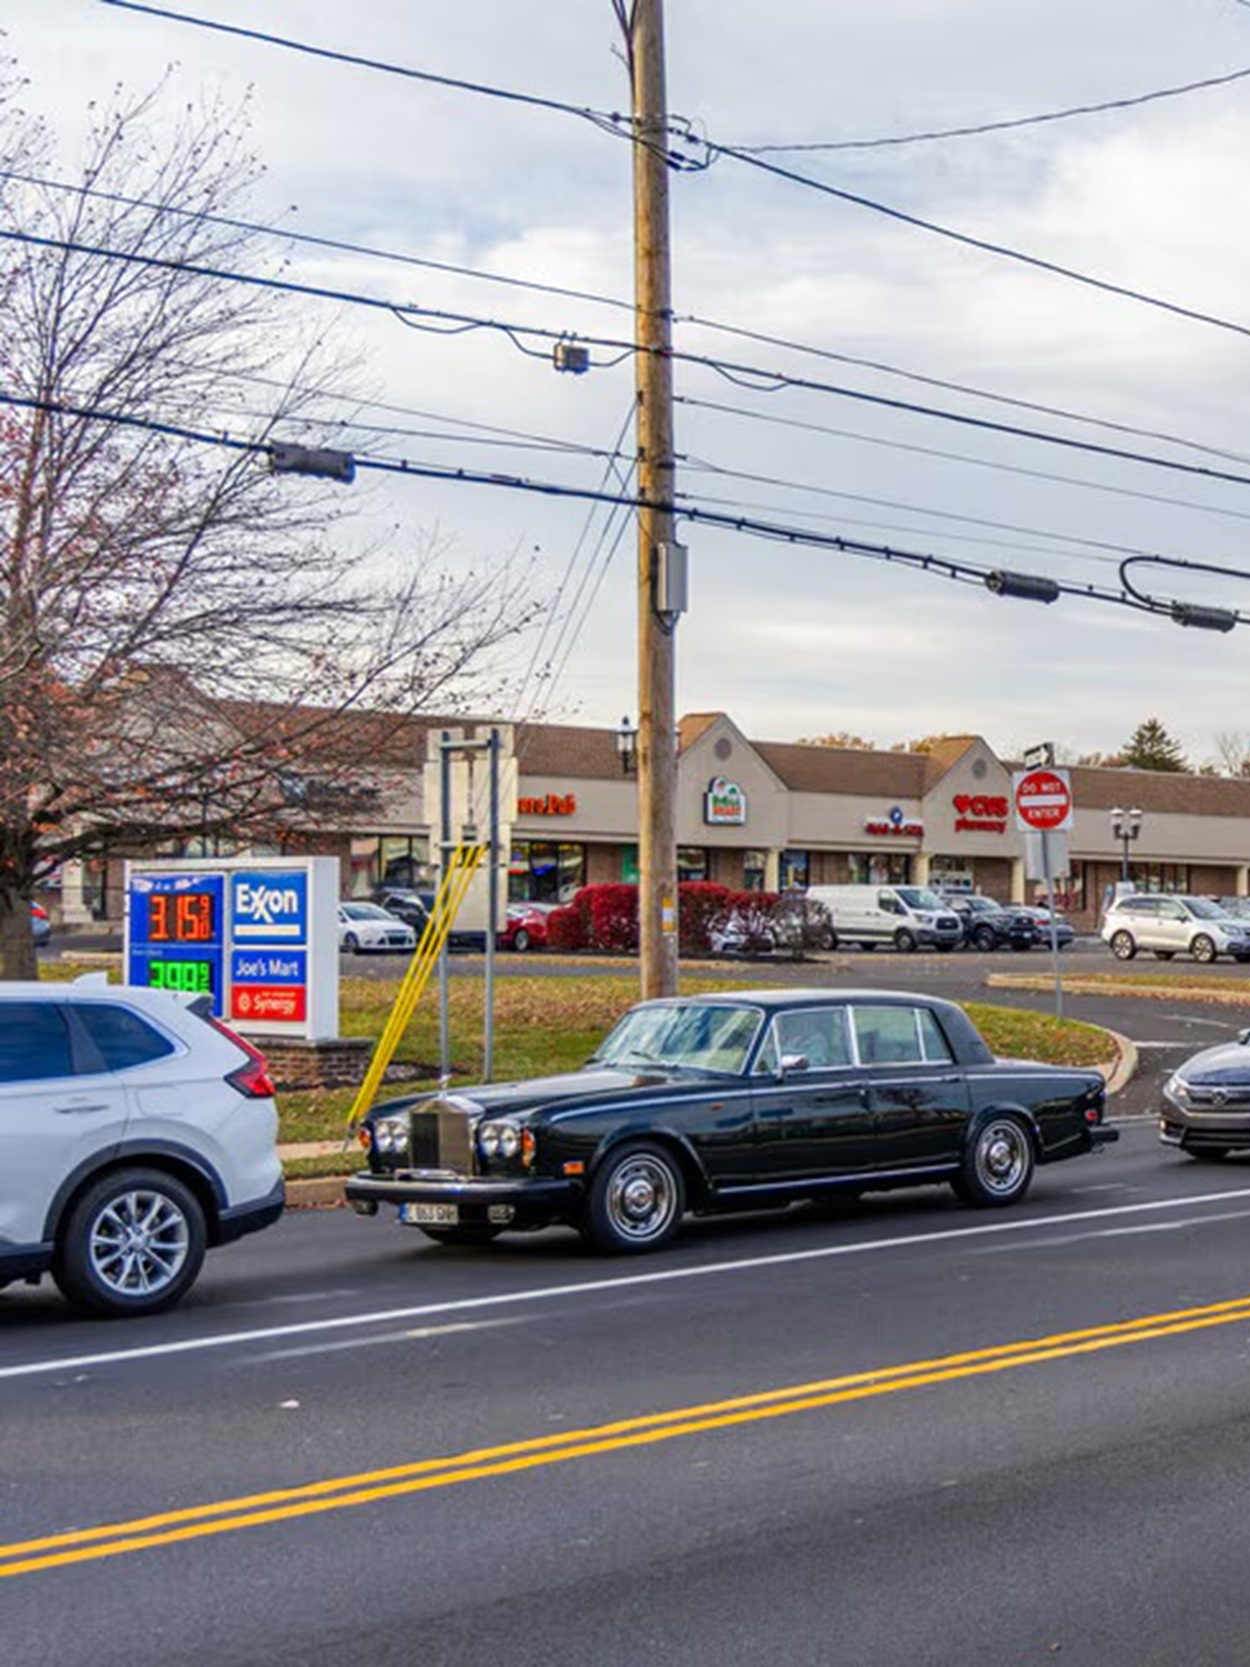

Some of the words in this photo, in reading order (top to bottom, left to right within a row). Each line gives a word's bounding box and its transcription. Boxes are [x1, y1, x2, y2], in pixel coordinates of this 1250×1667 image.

[1021, 782, 1037, 794] DO
[1041, 781, 1061, 793] NOT
[970, 795, 1008, 817] CVS
[1027, 808, 1060, 819] ENTER
[954, 819, 1007, 835] pharmacy
[235, 883, 299, 923] Exxon
[235, 958, 267, 977] Joe's
[268, 958, 299, 977] Mart
[253, 994, 297, 1016] Synergy
